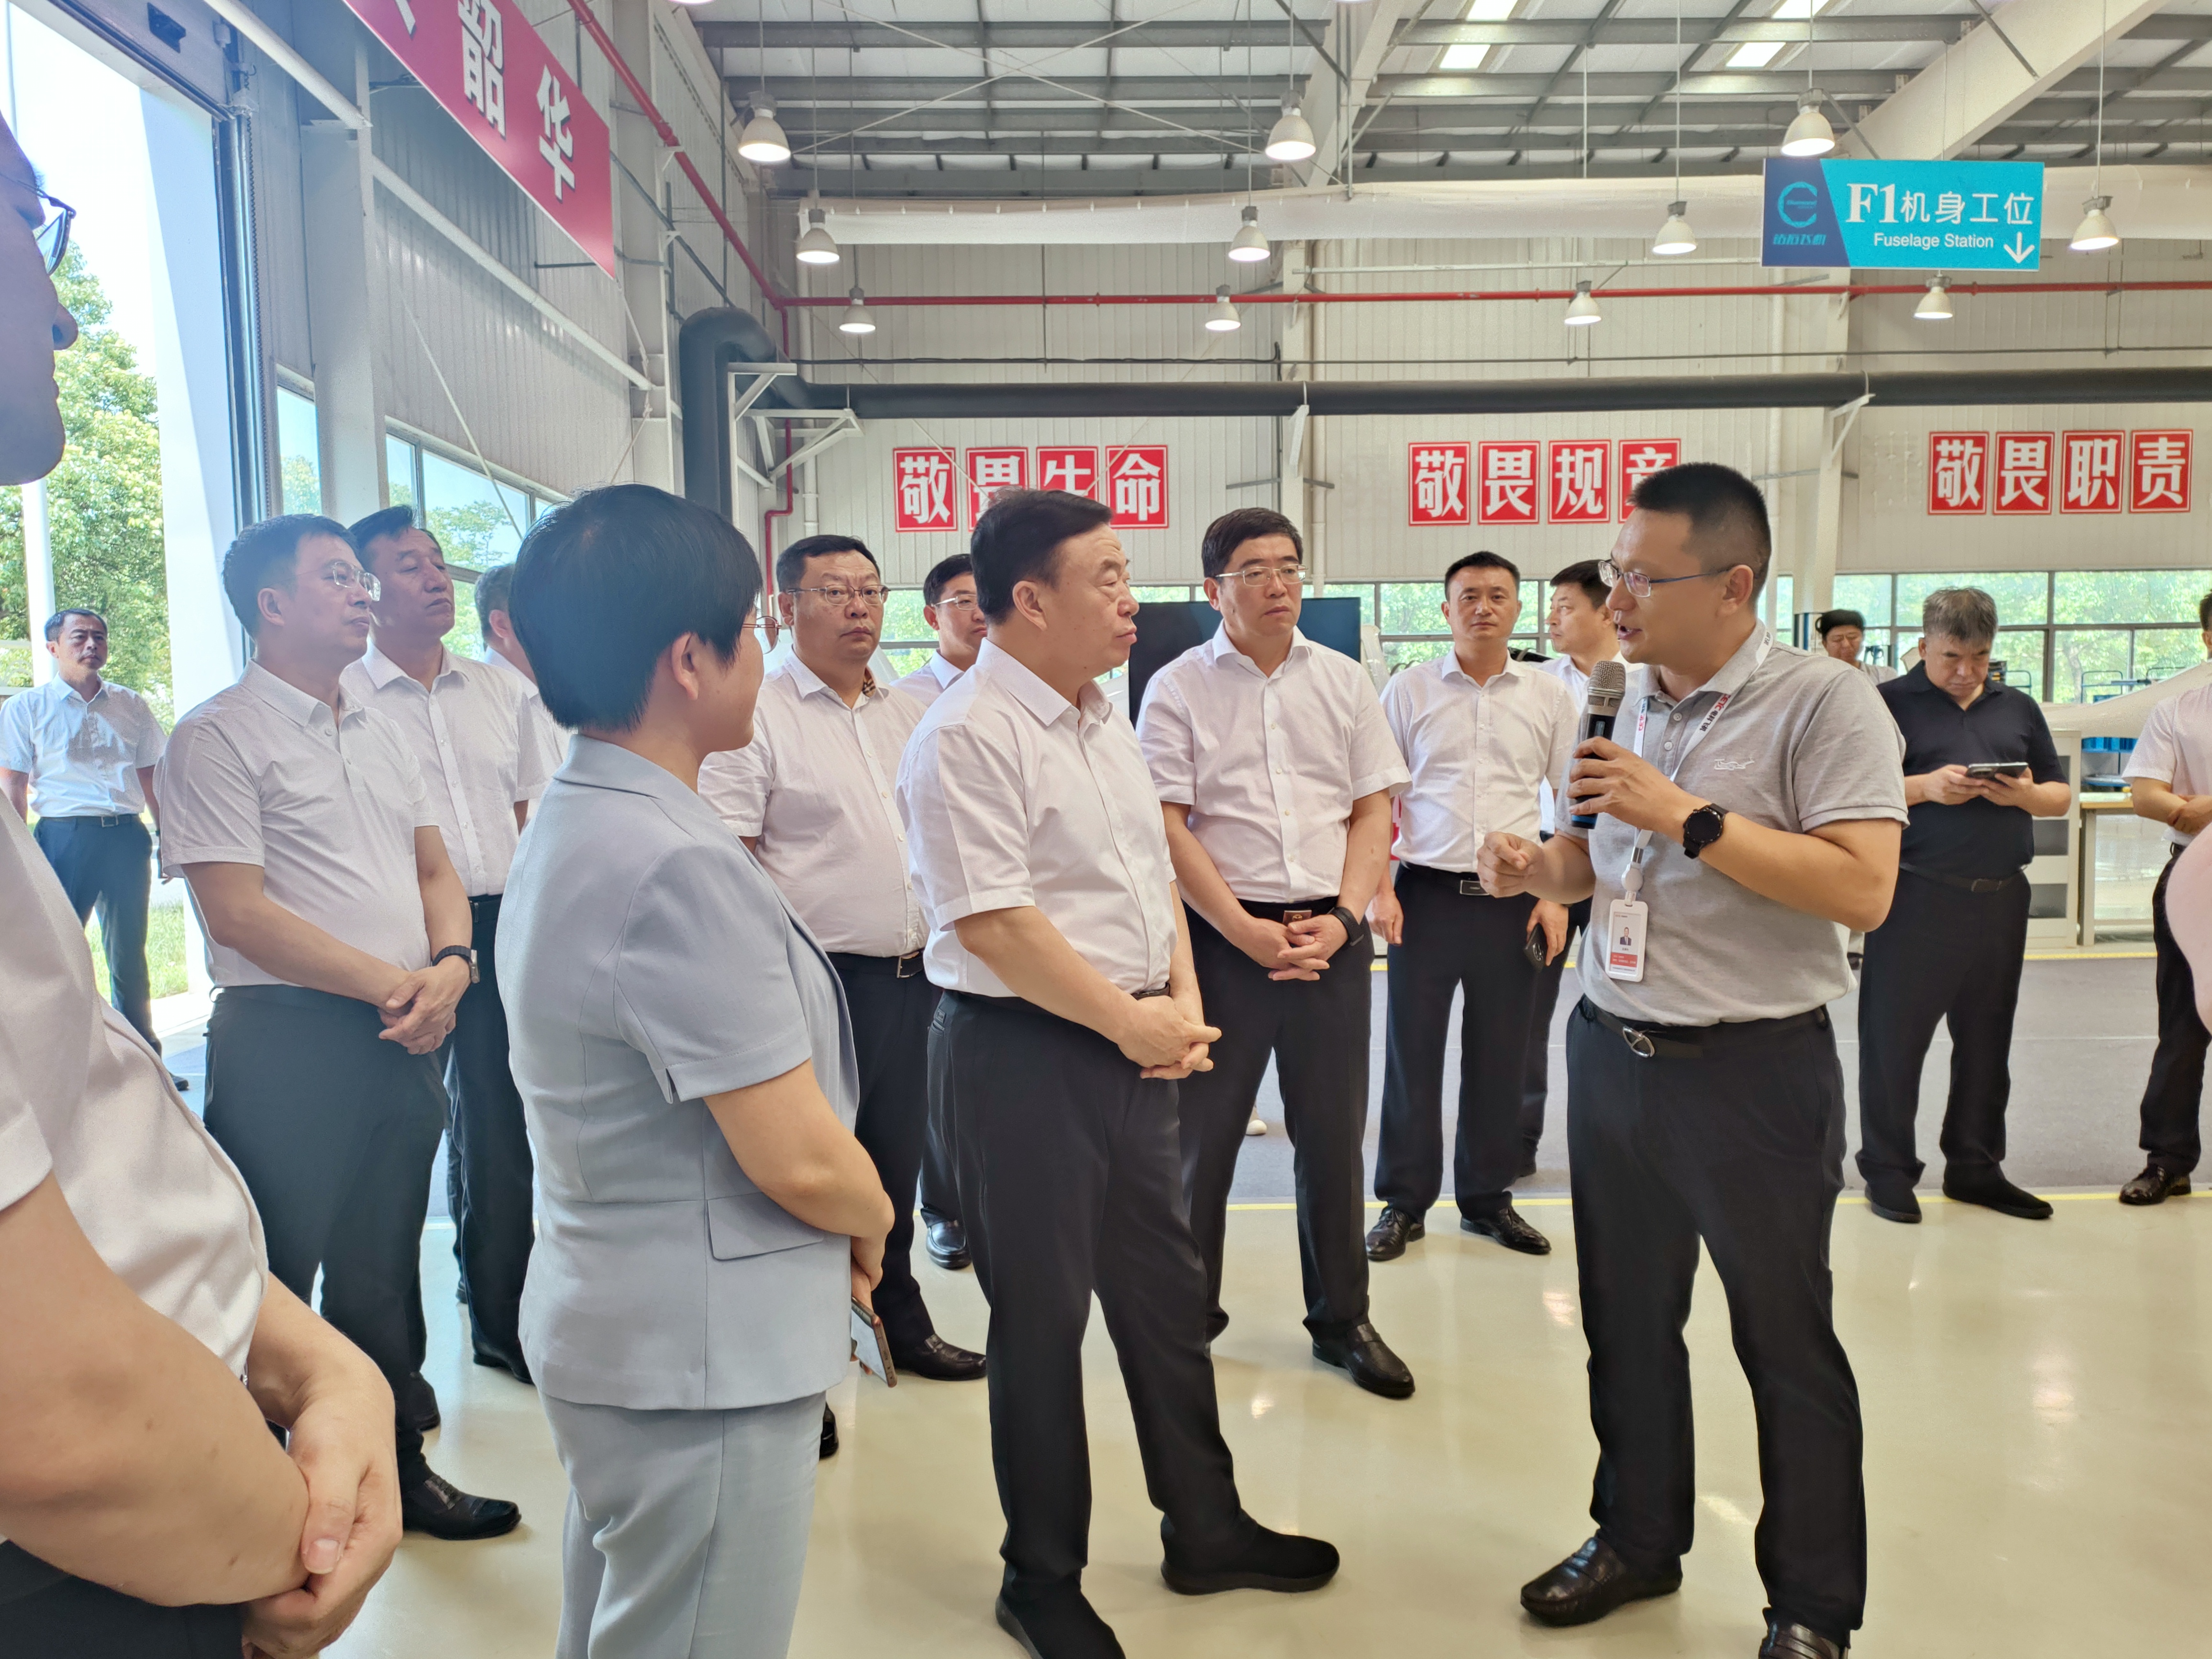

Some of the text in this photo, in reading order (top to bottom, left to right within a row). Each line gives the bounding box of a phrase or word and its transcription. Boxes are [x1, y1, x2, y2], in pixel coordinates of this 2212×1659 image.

[1874, 232, 1994, 250] Fuselage Station
[1936, 437, 2186, 507] 敬畏职责
